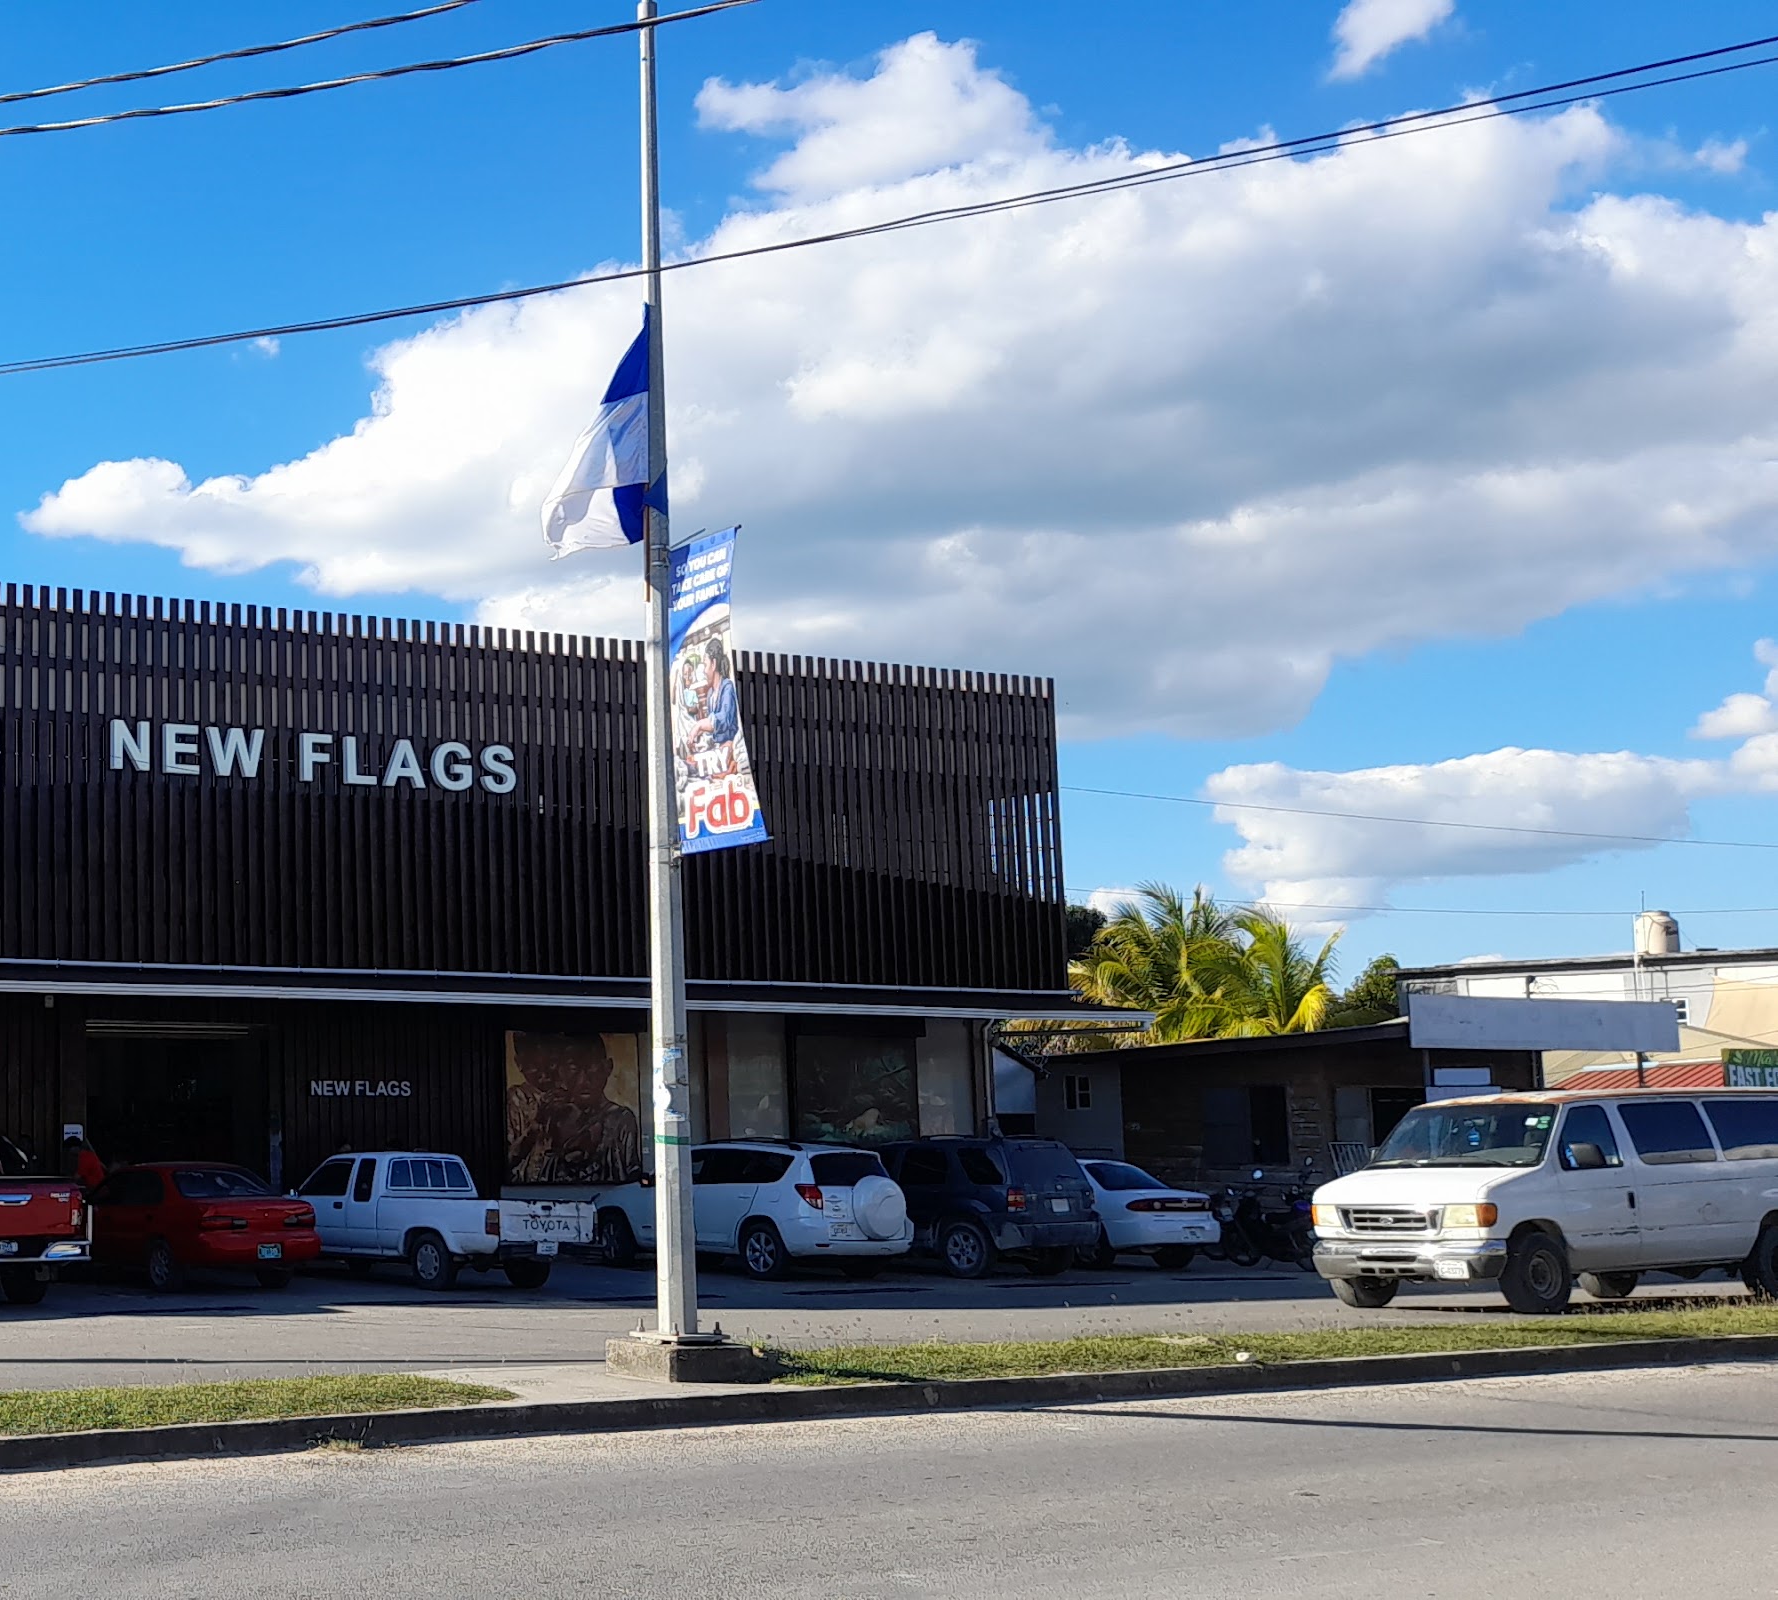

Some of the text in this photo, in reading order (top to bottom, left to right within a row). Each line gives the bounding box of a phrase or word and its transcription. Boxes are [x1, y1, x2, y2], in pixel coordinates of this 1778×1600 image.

[676, 547, 727, 578] SO YOU CAN
[672, 562, 730, 596] TAKE CARE OF
[672, 593, 695, 612] YOUR
[110, 719, 517, 794] NEW FLAGS
[694, 746, 730, 777] TRY
[687, 779, 752, 834] Fab
[310, 1080, 411, 1096] NEW FLAGS
[1729, 1064, 1761, 1087] FAST
[522, 1220, 570, 1231] TOYOTA
